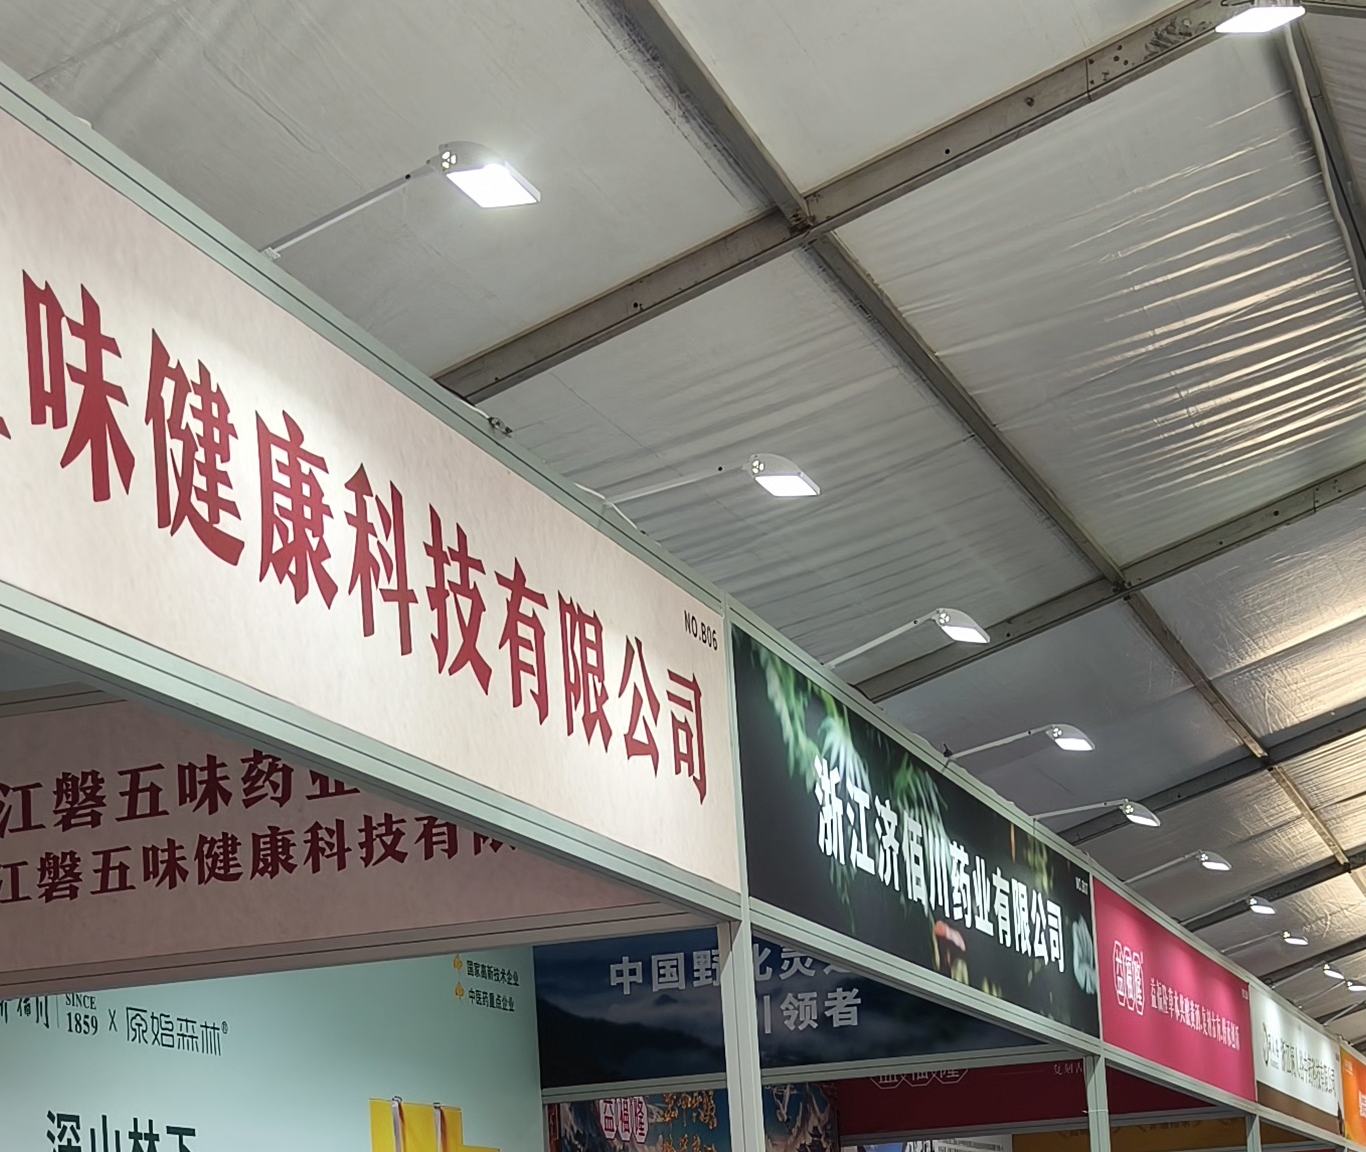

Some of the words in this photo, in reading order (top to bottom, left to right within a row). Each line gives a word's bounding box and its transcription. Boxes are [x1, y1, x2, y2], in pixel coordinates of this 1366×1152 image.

[684, 610, 718, 651] NO.B06
[813, 754, 1065, 974] 浙江济佰川药业有限公司
[466, 959, 520, 988] 国家高新技术企业
[66, 1012, 99, 1036] 1859
